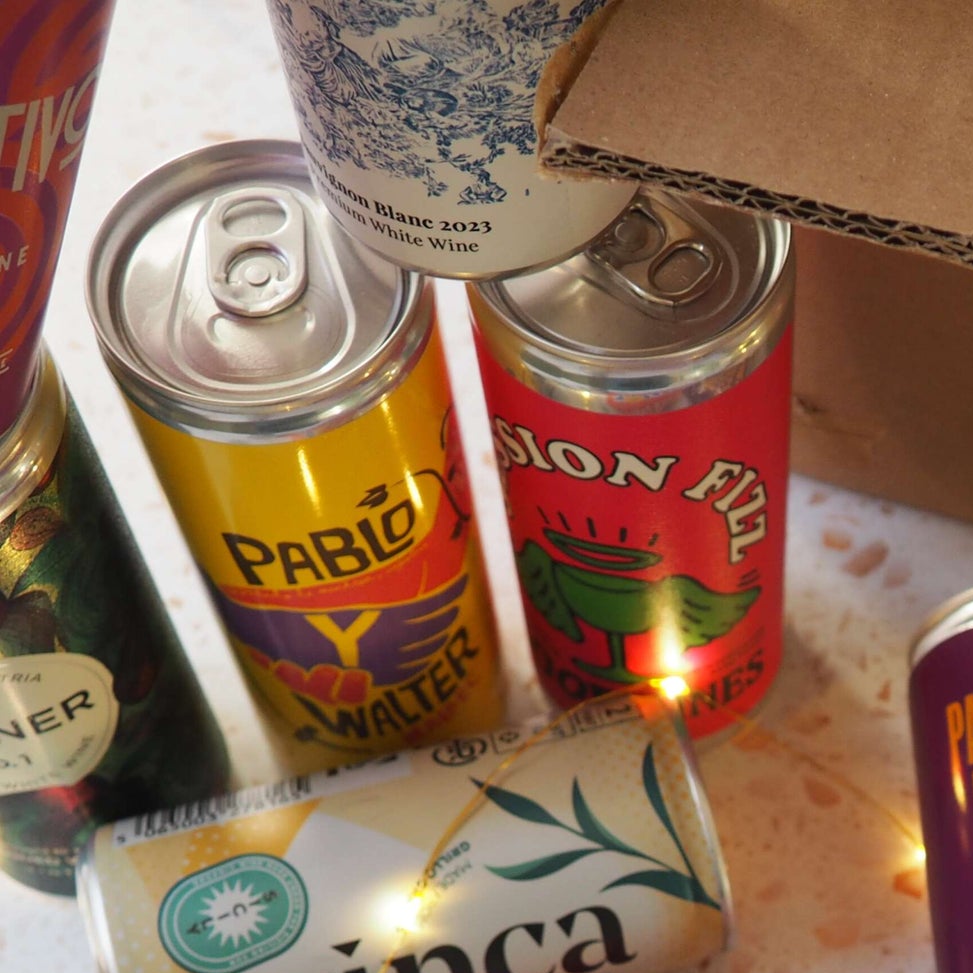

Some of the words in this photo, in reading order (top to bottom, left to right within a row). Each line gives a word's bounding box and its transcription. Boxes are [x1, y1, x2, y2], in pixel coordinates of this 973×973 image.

[369, 217, 424, 247] White
[428, 236, 480, 253] Wine
[372, 200, 434, 231] Blanc
[439, 220, 492, 234] 2023
[682, 457, 768, 566] FIZZ
[221, 498, 416, 586] PABLO
[304, 610, 382, 668] Y
[291, 624, 480, 740] WALTER
[186, 888, 279, 937] SICILY
